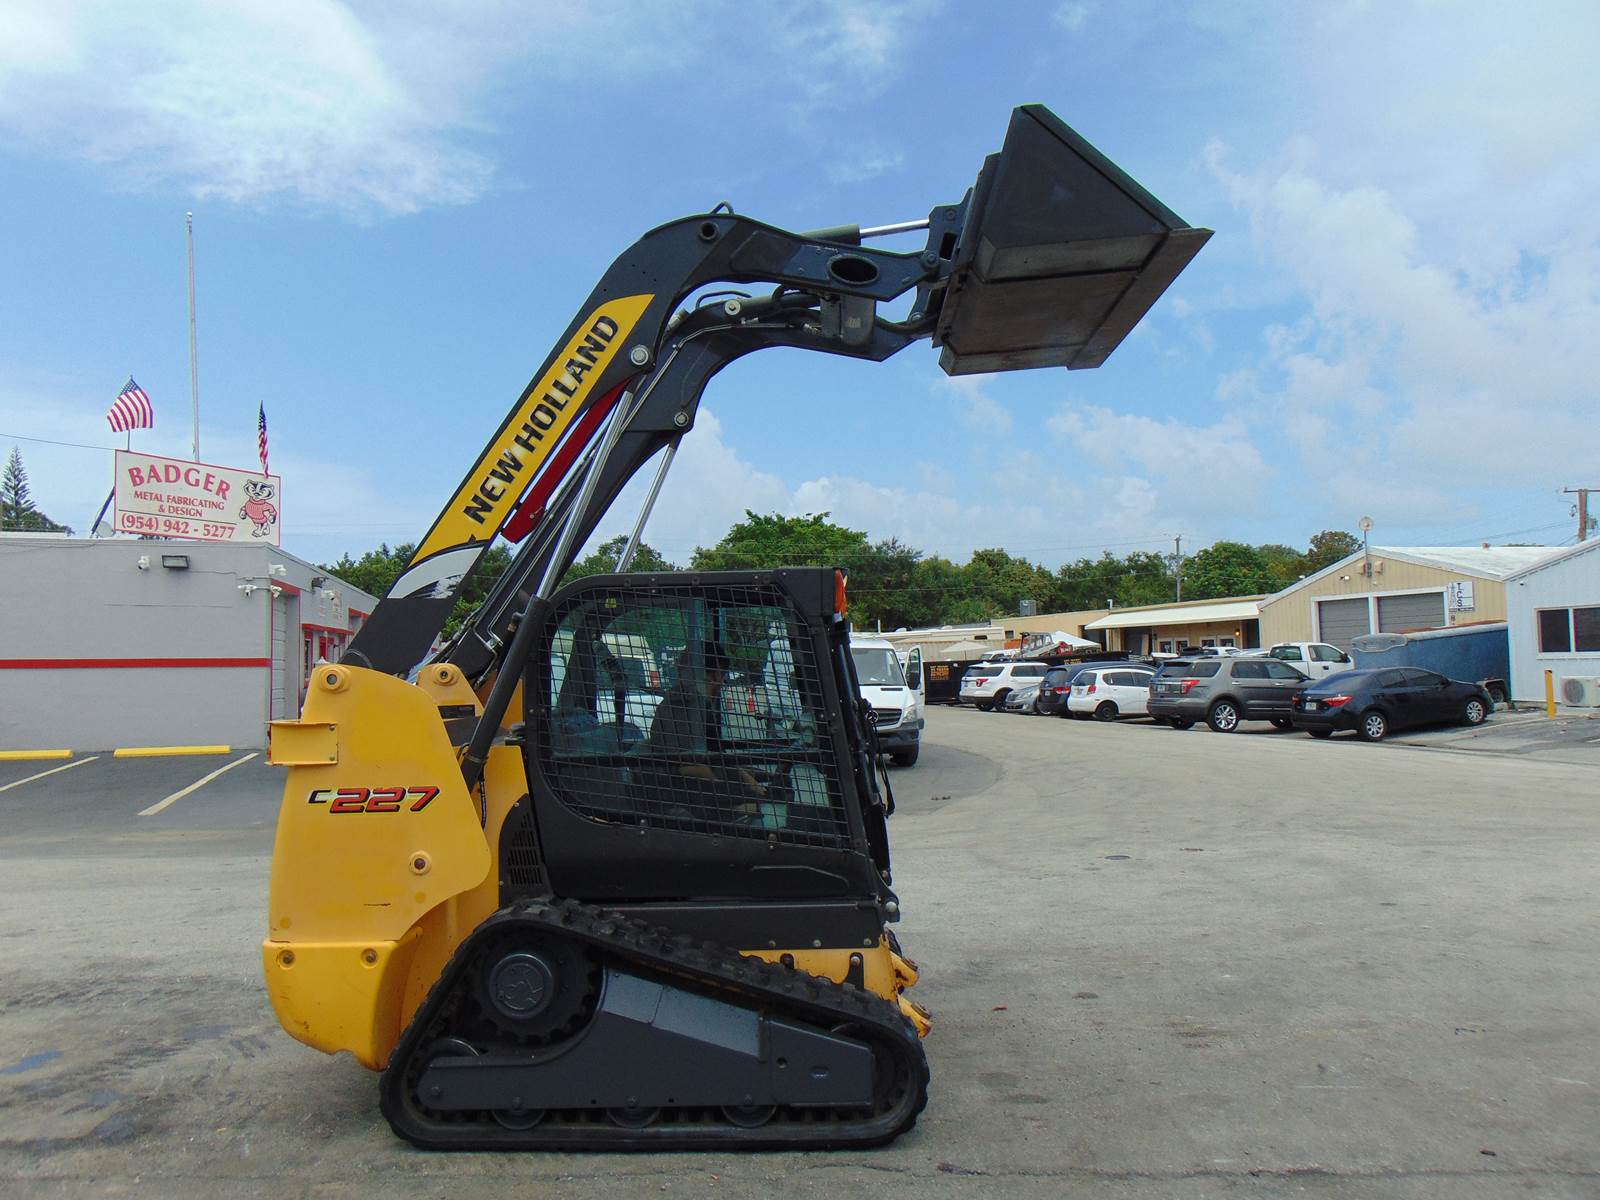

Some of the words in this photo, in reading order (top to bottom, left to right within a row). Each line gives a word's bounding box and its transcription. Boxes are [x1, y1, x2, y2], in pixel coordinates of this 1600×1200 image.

[462, 450, 524, 525] NEW
[513, 315, 620, 453] HOLLAND
[128, 464, 231, 500] BADGER
[134, 490, 164, 503] METAL
[167, 495, 225, 511] FABRICATING
[159, 504, 165, 513] &
[168, 505, 203, 517] DESIGN
[121, 513, 159, 532] (954)
[163, 519, 189, 535] 942
[203, 524, 236, 539] 5277
[308, 786, 440, 814] C227
